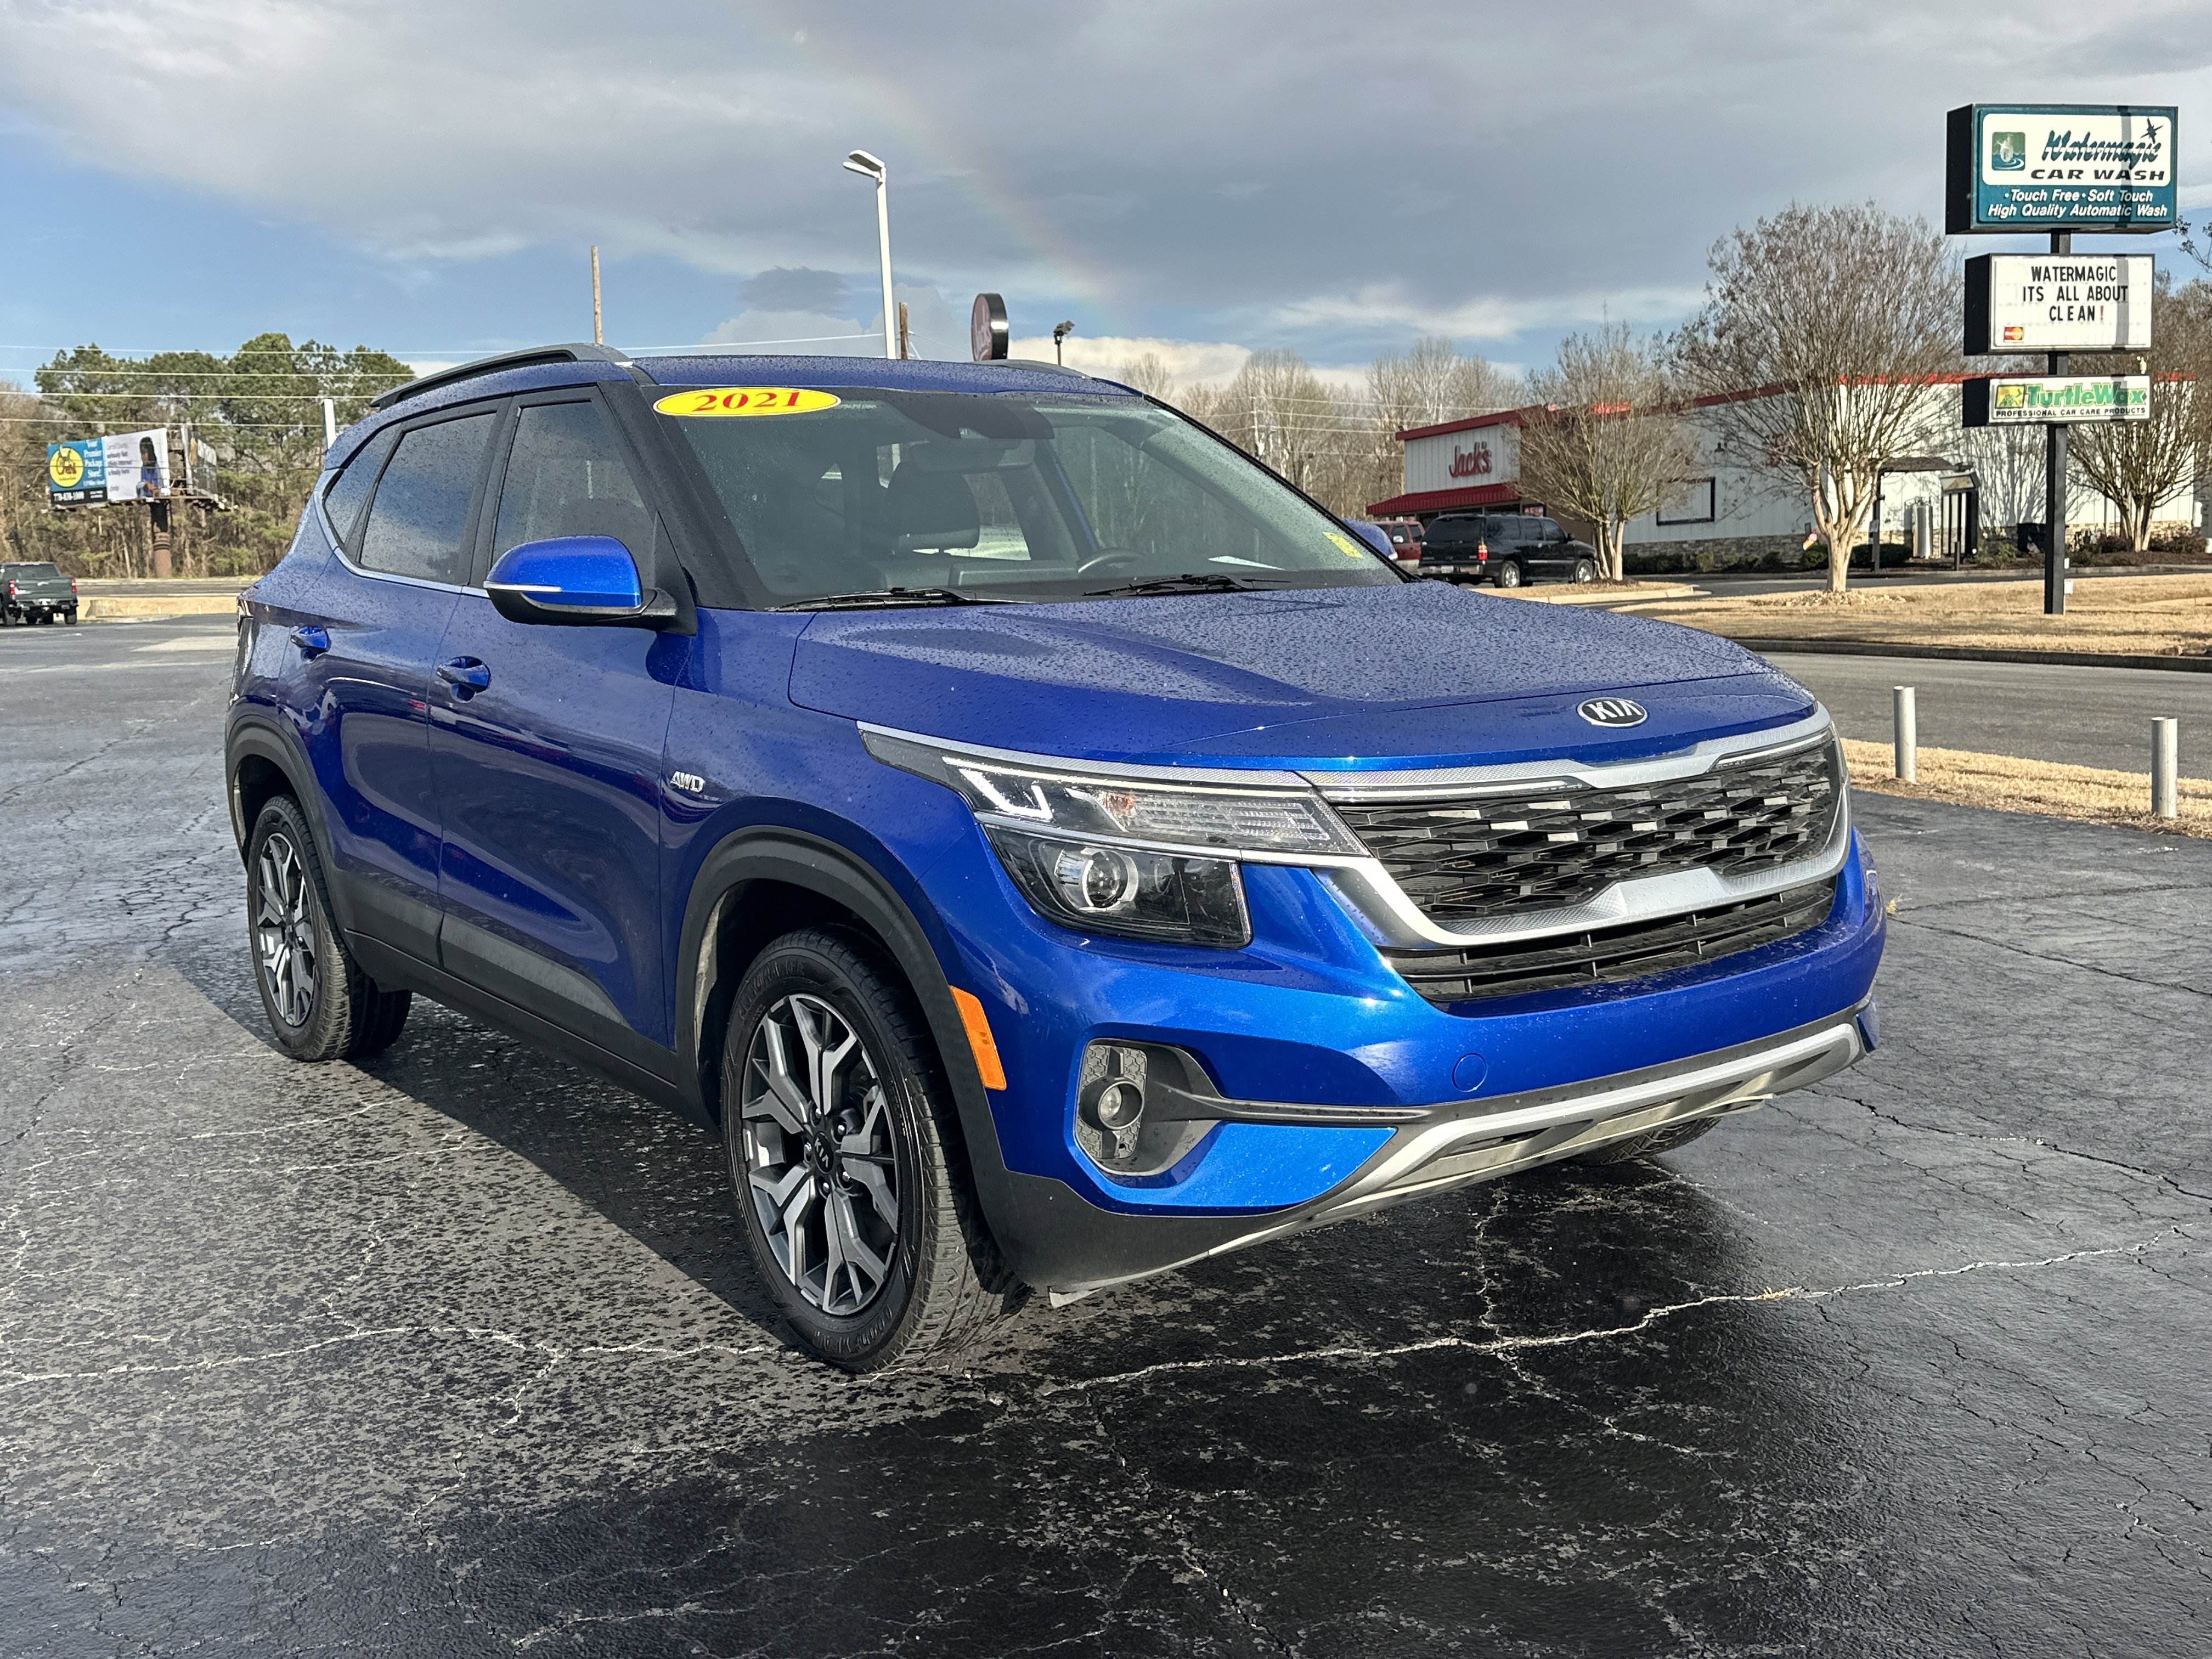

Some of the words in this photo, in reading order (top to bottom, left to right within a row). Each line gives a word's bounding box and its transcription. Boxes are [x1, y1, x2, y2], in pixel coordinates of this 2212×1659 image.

[2030, 169, 2084, 180] CAR
[2093, 169, 2165, 180] WASH
[2011, 188, 2047, 201] Touch
[2051, 189, 2080, 201] Free
[2087, 189, 2114, 201] Soft
[2119, 190, 2153, 202] Touch
[1988, 204, 2017, 218] High
[2022, 204, 2067, 218] Quality
[2069, 205, 2132, 216] Automatic
[2137, 205, 2168, 217] Wash
[2030, 266, 2117, 282] WATERMAGIC
[2023, 285, 2044, 302] ITS
[2057, 285, 2079, 302] ALL
[2086, 285, 2128, 302] ABOUT
[691, 391, 801, 412] 2021
[1996, 409, 2057, 417] PROFESSIONAL
[1448, 441, 1492, 478] Jack's
[1585, 699, 1643, 720] KIA
[670, 771, 705, 792] AWD
